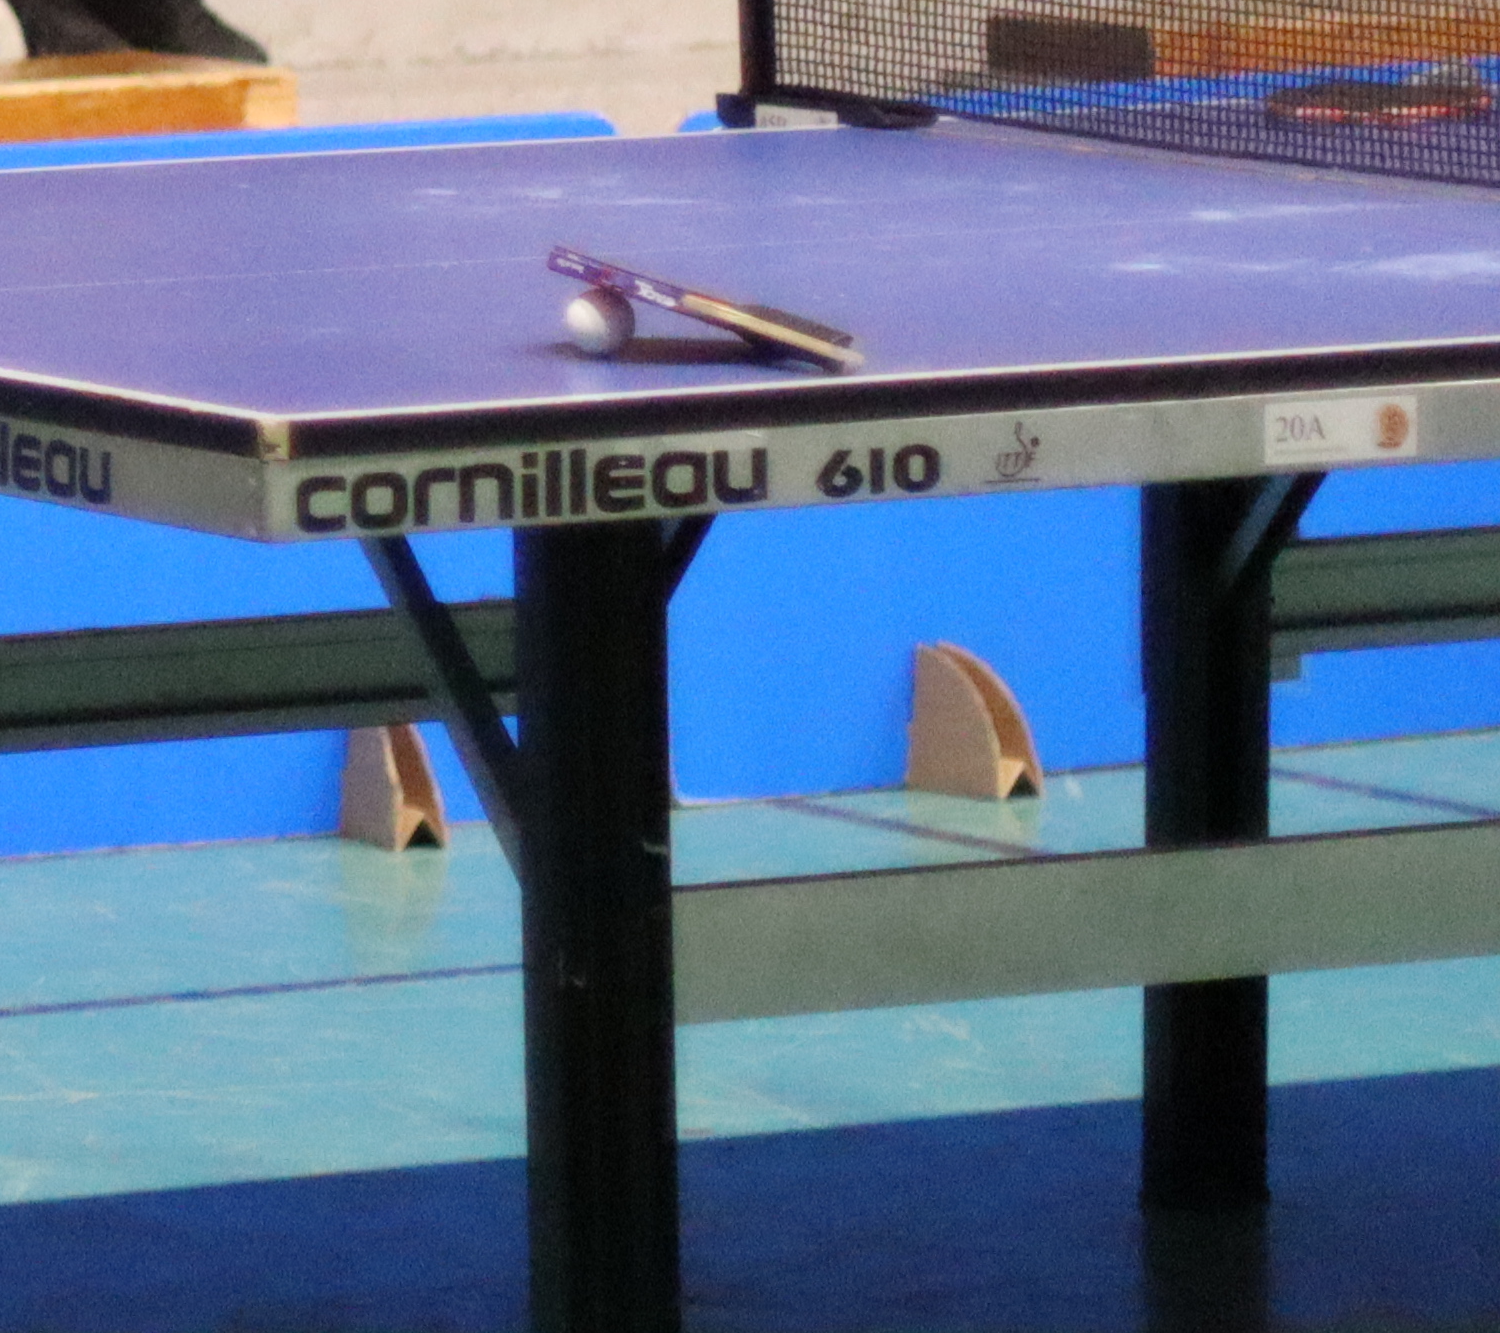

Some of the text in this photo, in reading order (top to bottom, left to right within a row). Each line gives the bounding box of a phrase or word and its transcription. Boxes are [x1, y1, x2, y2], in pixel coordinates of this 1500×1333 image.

[1276, 414, 1327, 443] 20A
[295, 443, 942, 534] cornilleau 610
